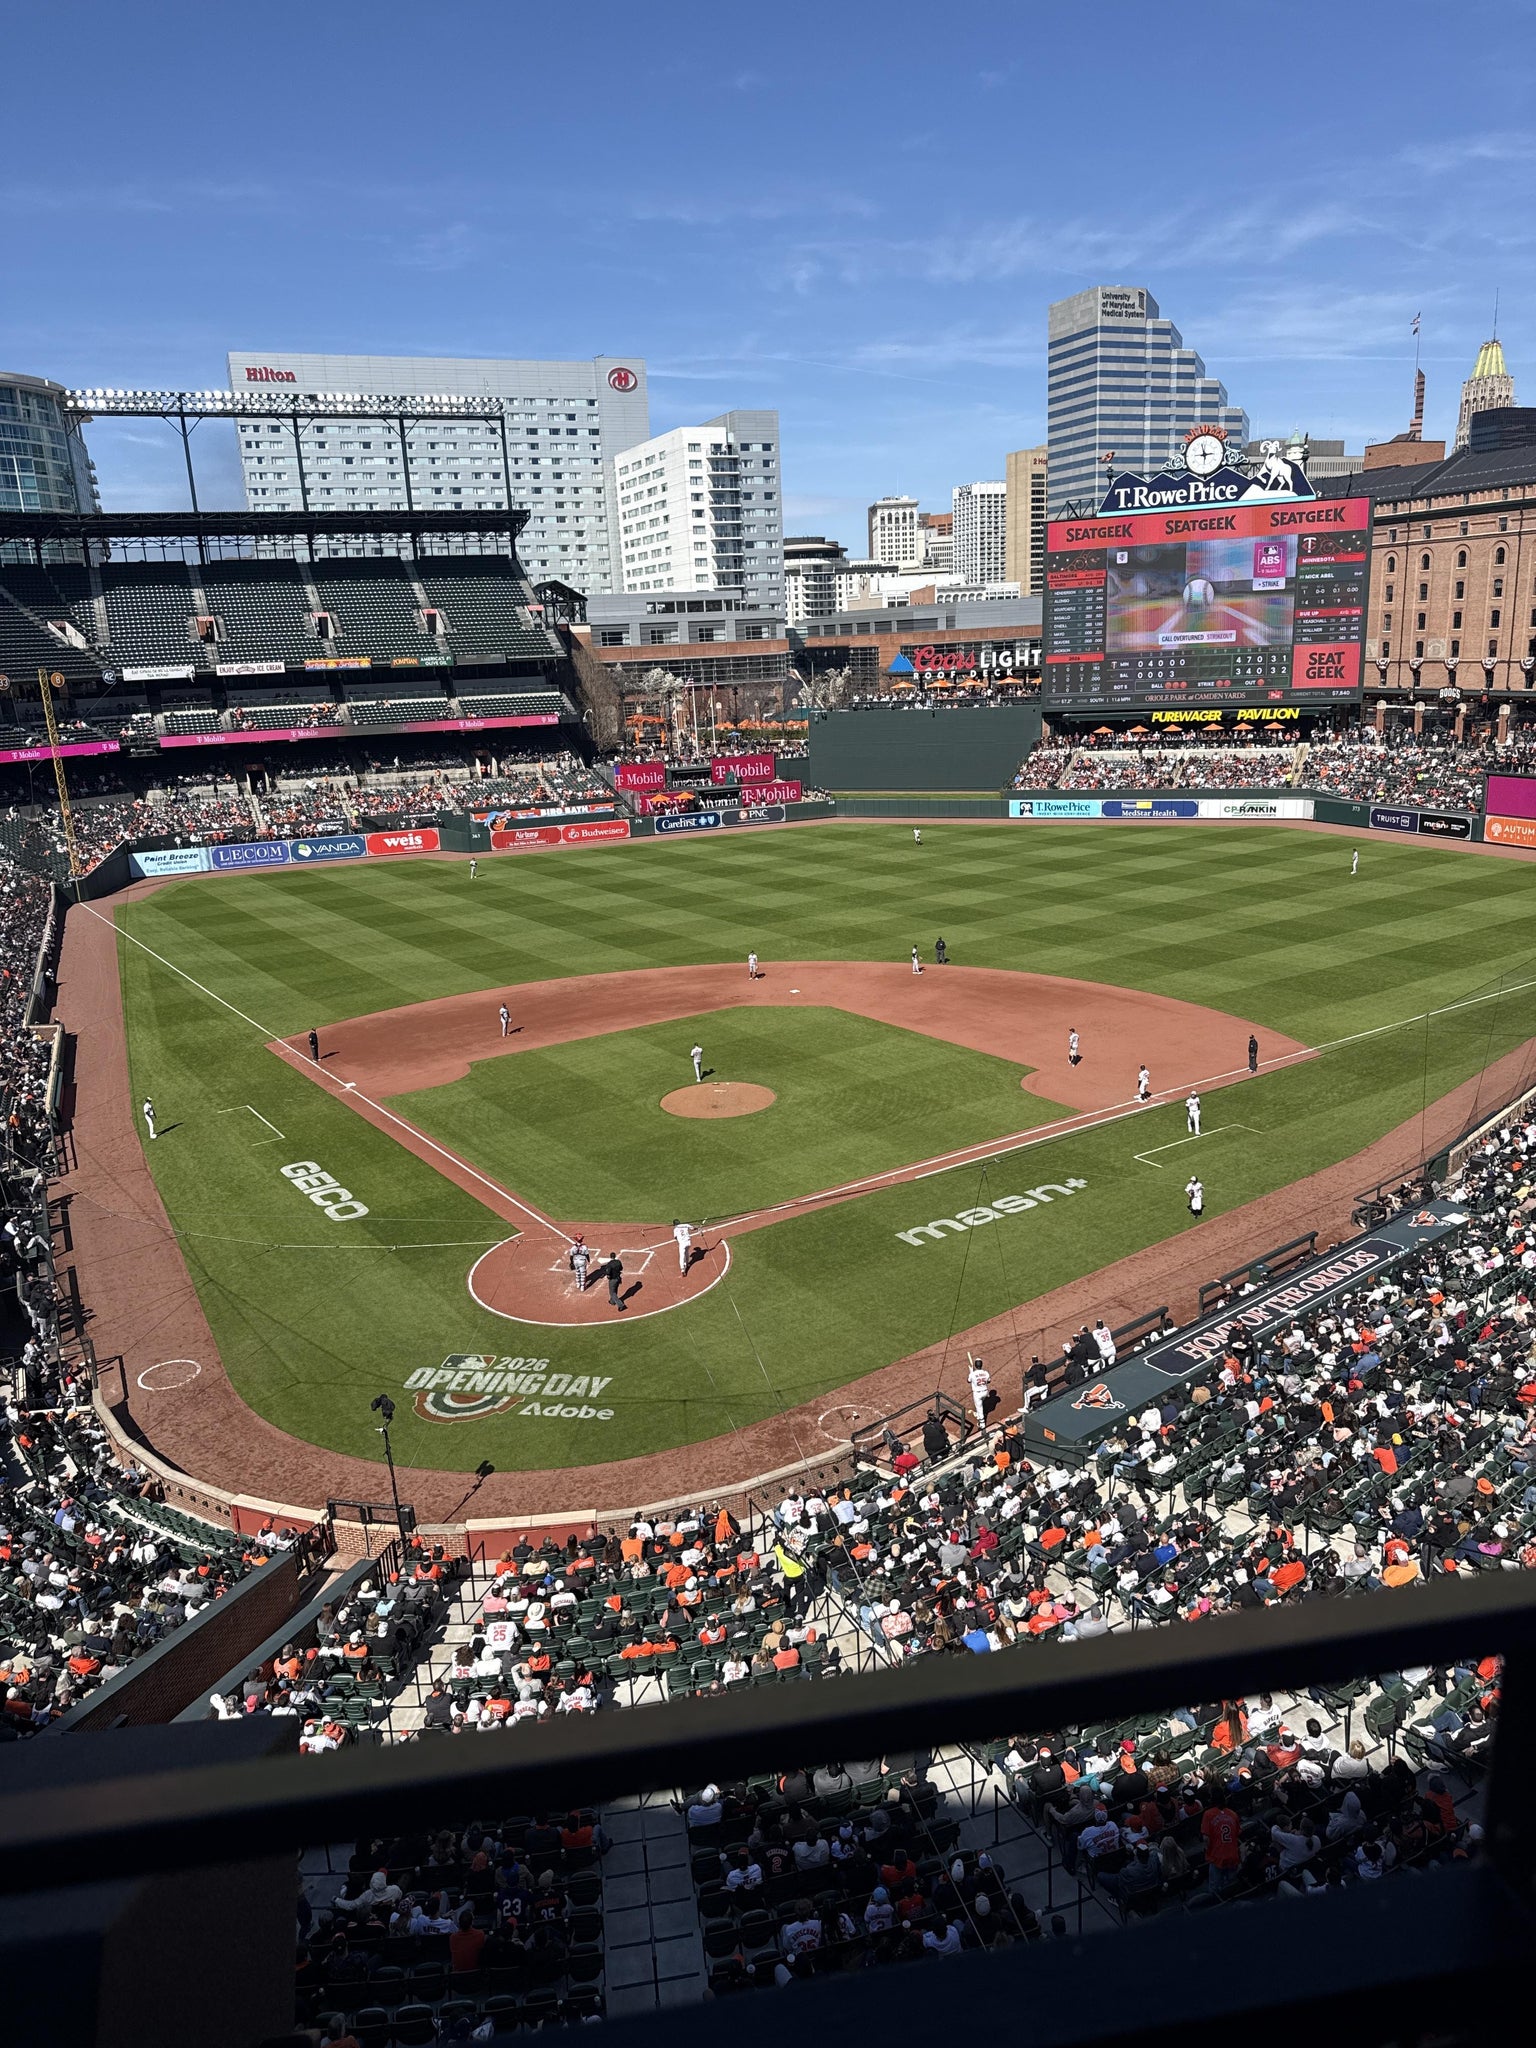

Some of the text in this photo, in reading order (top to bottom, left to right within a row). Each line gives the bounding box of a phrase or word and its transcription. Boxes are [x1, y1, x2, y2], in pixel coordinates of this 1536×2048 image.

[1102, 292, 1131, 301] University
[1109, 301, 1135, 310] Maryland
[1101, 309, 1144, 318] Medical System
[245, 366, 297, 383] Hilton
[1066, 507, 1346, 542] SEATGEEK SEATGEEK SEATGEEK
[1260, 555, 1280, 566] ABS
[1174, 634, 1204, 642] OVERTURNED
[914, 645, 1042, 671] Coors LIGHT
[1138, 660, 1143, 668] 0
[1180, 658, 1185, 666] 0
[1309, 652, 1345, 666] SEAT
[219, 666, 235, 674] ENJOY
[914, 668, 1013, 680] ROOF DECK
[1137, 671, 1143, 679] 0
[1169, 670, 1175, 678] 3
[1236, 667, 1242, 675] 3
[1306, 666, 1345, 680] GEEK
[104, 672, 114, 682] 42
[1169, 693, 1187, 701] PARK
[1151, 708, 1300, 722] PUREWAGER PAVILION
[729, 763, 771, 778] Mobile
[627, 771, 664, 786] Mobile
[541, 807, 563, 816] BIRD
[565, 805, 588, 814] BATH
[749, 809, 767, 818] PNC
[661, 817, 698, 830] CareFirst
[1377, 814, 1400, 824] TRUIST
[582, 826, 625, 838] Budweiser
[383, 833, 422, 847] weis
[219, 845, 283, 862] LECOM
[312, 842, 360, 854] VANDA
[169, 853, 199, 861] Breeze
[280, 1161, 370, 1221] GEICO
[1242, 1303, 1272, 1329] OF
[1262, 1287, 1315, 1312] THE
[1299, 1250, 1380, 1294] ORIOLES
[1101, 1333, 1110, 1343] 35
[493, 1356, 550, 1372] 2026
[403, 1366, 613, 1398] OPENING DAY
[977, 1378, 987, 1387] 25
[518, 1402, 615, 1420] Adobe
[988, 1608, 997, 1622] 2
[493, 1630, 506, 1642] 25
[455, 1667, 470, 1679] 35
[1221, 1824, 1233, 1843] 2
[771, 1856, 782, 1873] 2
[502, 1898, 521, 1917] 23
